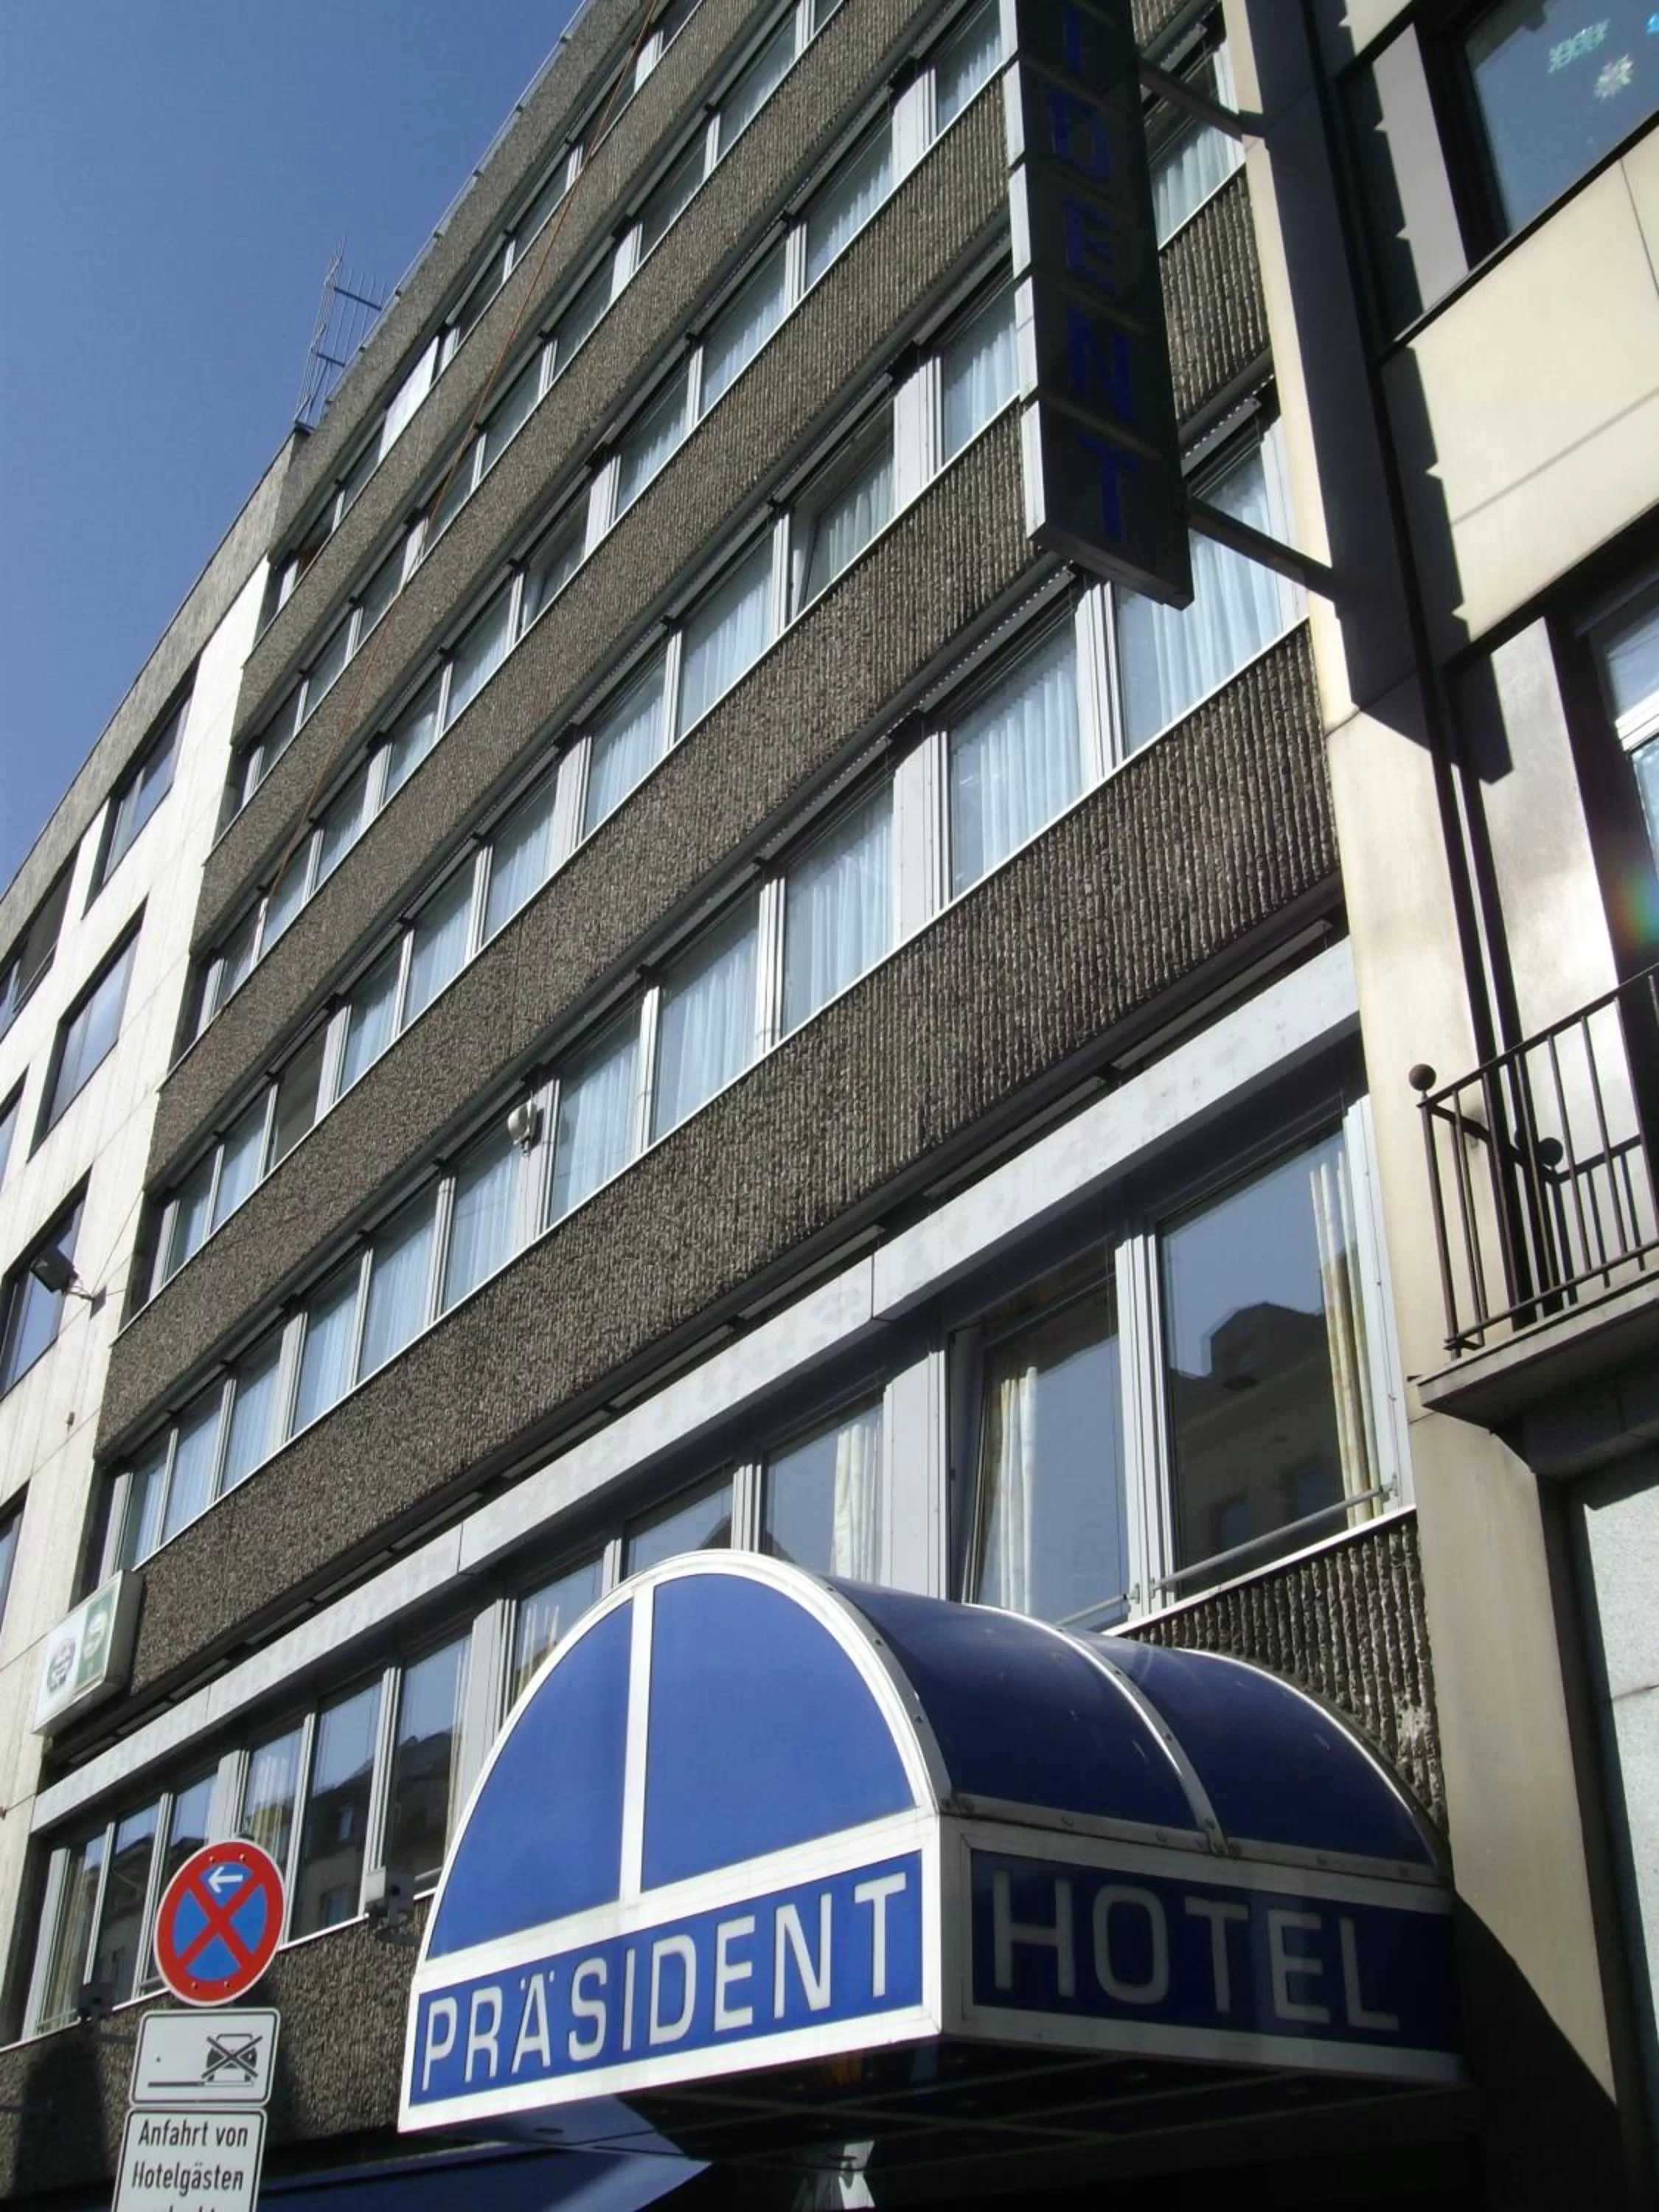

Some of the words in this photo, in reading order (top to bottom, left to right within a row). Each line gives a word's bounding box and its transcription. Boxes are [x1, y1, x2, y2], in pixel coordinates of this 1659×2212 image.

[422, 1871, 907, 2092] PRÄSIDENT
[992, 1870, 1399, 2031] HOTEL
[132, 2160, 244, 2197] Hotelgästen
[138, 2118, 209, 2146] Anfahrt
[216, 2127, 248, 2147] von
